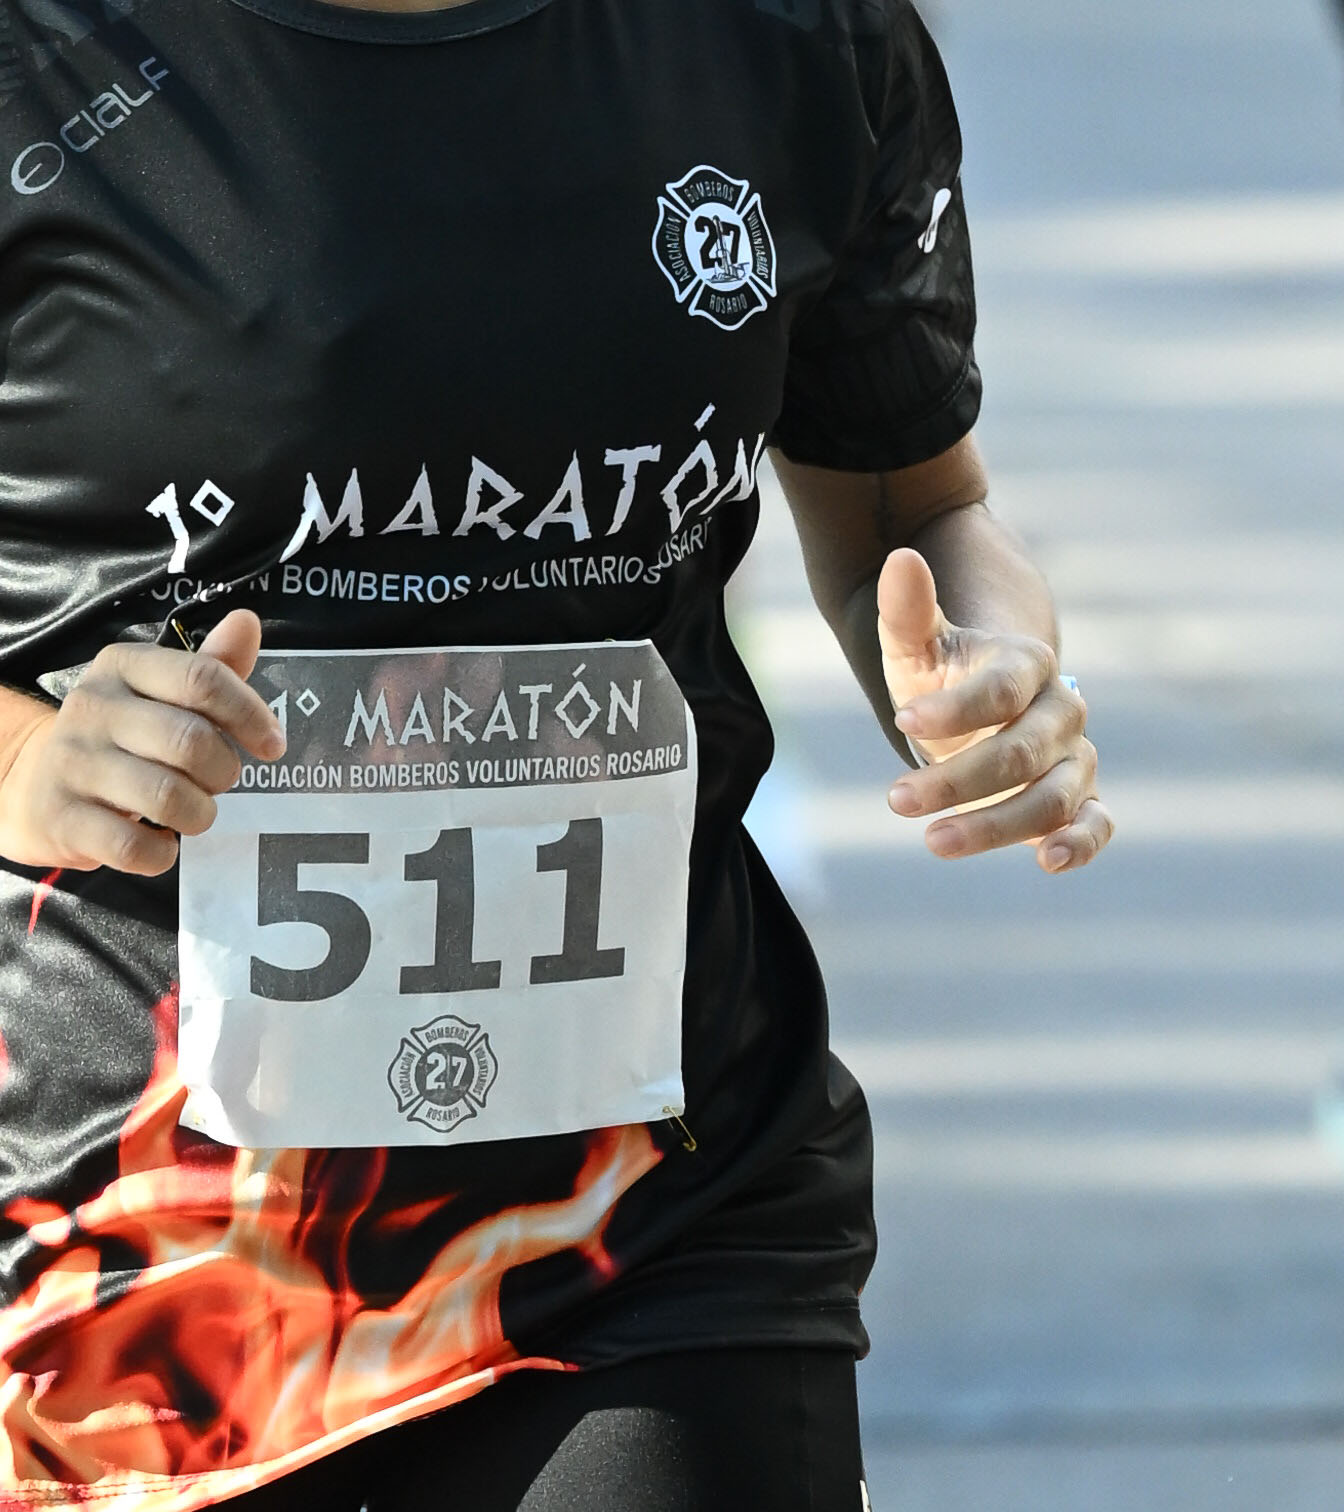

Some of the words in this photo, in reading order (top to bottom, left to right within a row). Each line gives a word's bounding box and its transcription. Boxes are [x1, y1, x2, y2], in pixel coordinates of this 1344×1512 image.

[684, 181, 735, 203] BOMBEROS
[694, 215, 741, 270] 27
[709, 294, 748, 314] ROSARIO
[280, 402, 765, 564] MARATÓN
[281, 563, 471, 604] BOMBEROS
[343, 662, 642, 748] MARATÓN
[231, 759, 342, 788] OCIACIÓN
[350, 759, 460, 788] BOMBEROS
[466, 754, 601, 784] VOLUNTARIOS
[606, 743, 682, 775] ROSARIO
[249, 817, 626, 1002] 511
[424, 1026, 469, 1043] BOMBEROS
[425, 1051, 467, 1091] 27
[425, 1107, 460, 1122] ROSARIO
